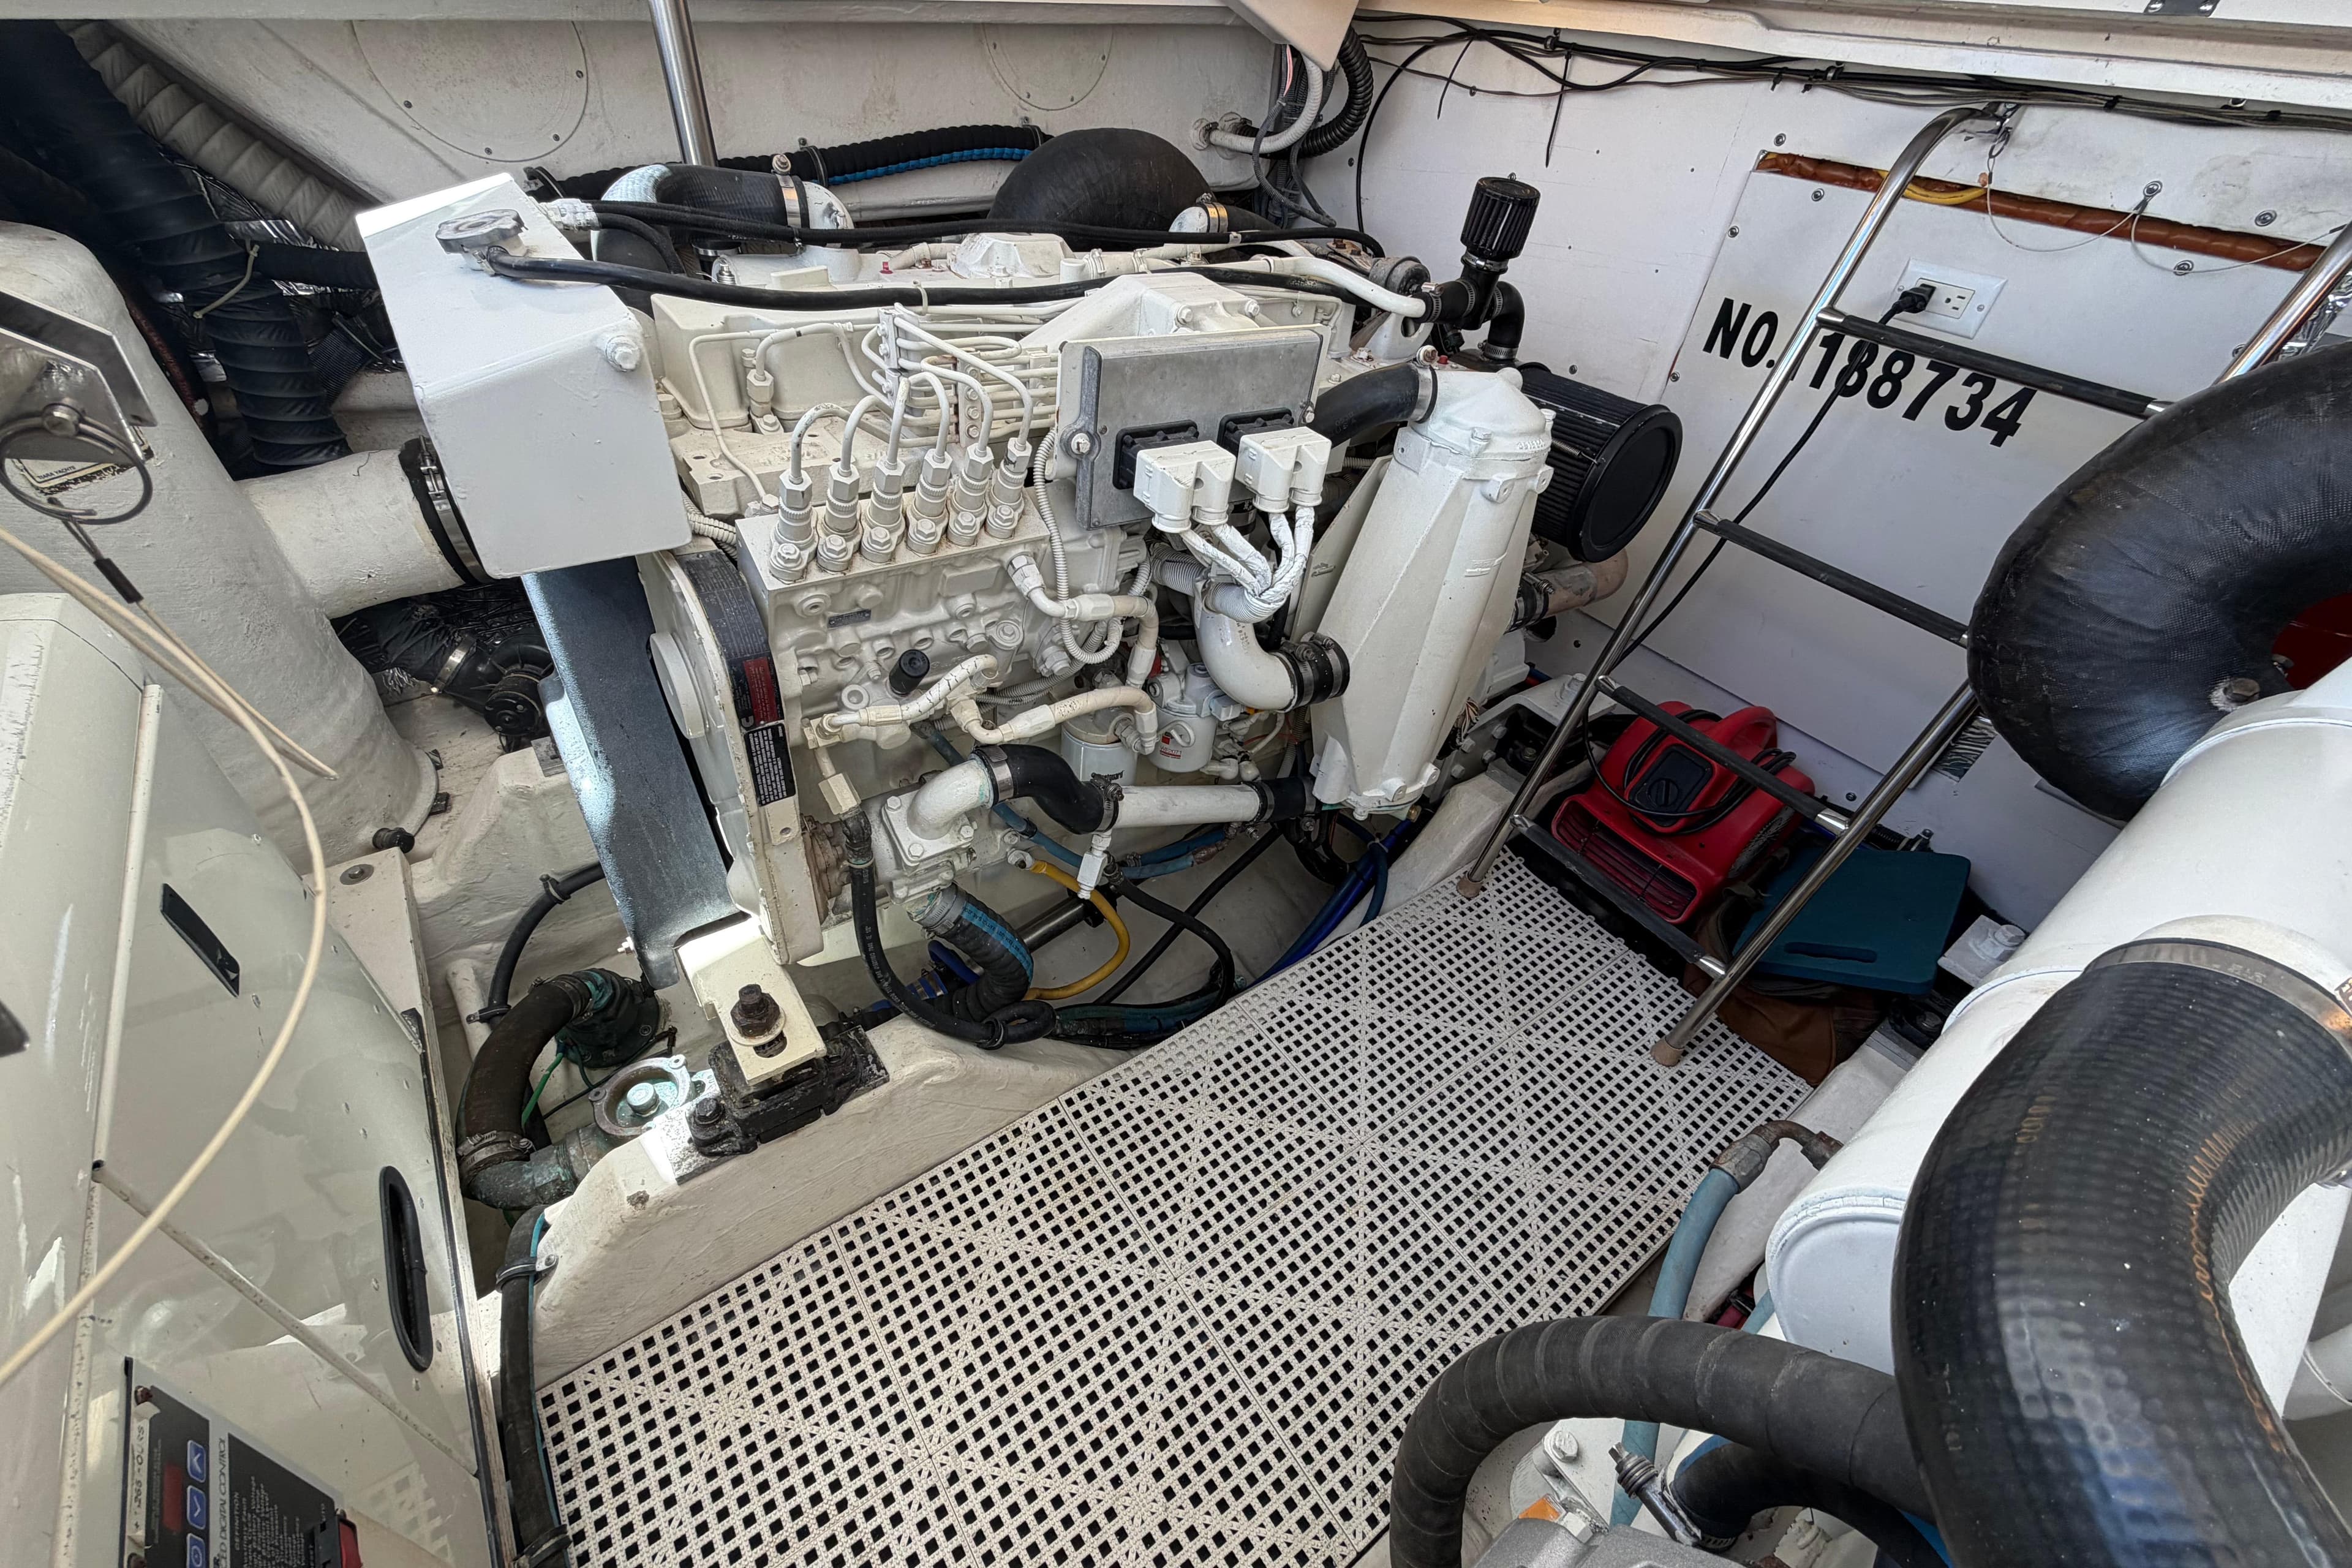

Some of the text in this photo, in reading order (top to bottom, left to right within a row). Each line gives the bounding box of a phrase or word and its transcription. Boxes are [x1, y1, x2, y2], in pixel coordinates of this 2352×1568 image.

[1703, 297, 2038, 447] NO. 188734
[37, 471, 55, 480] TIARA
